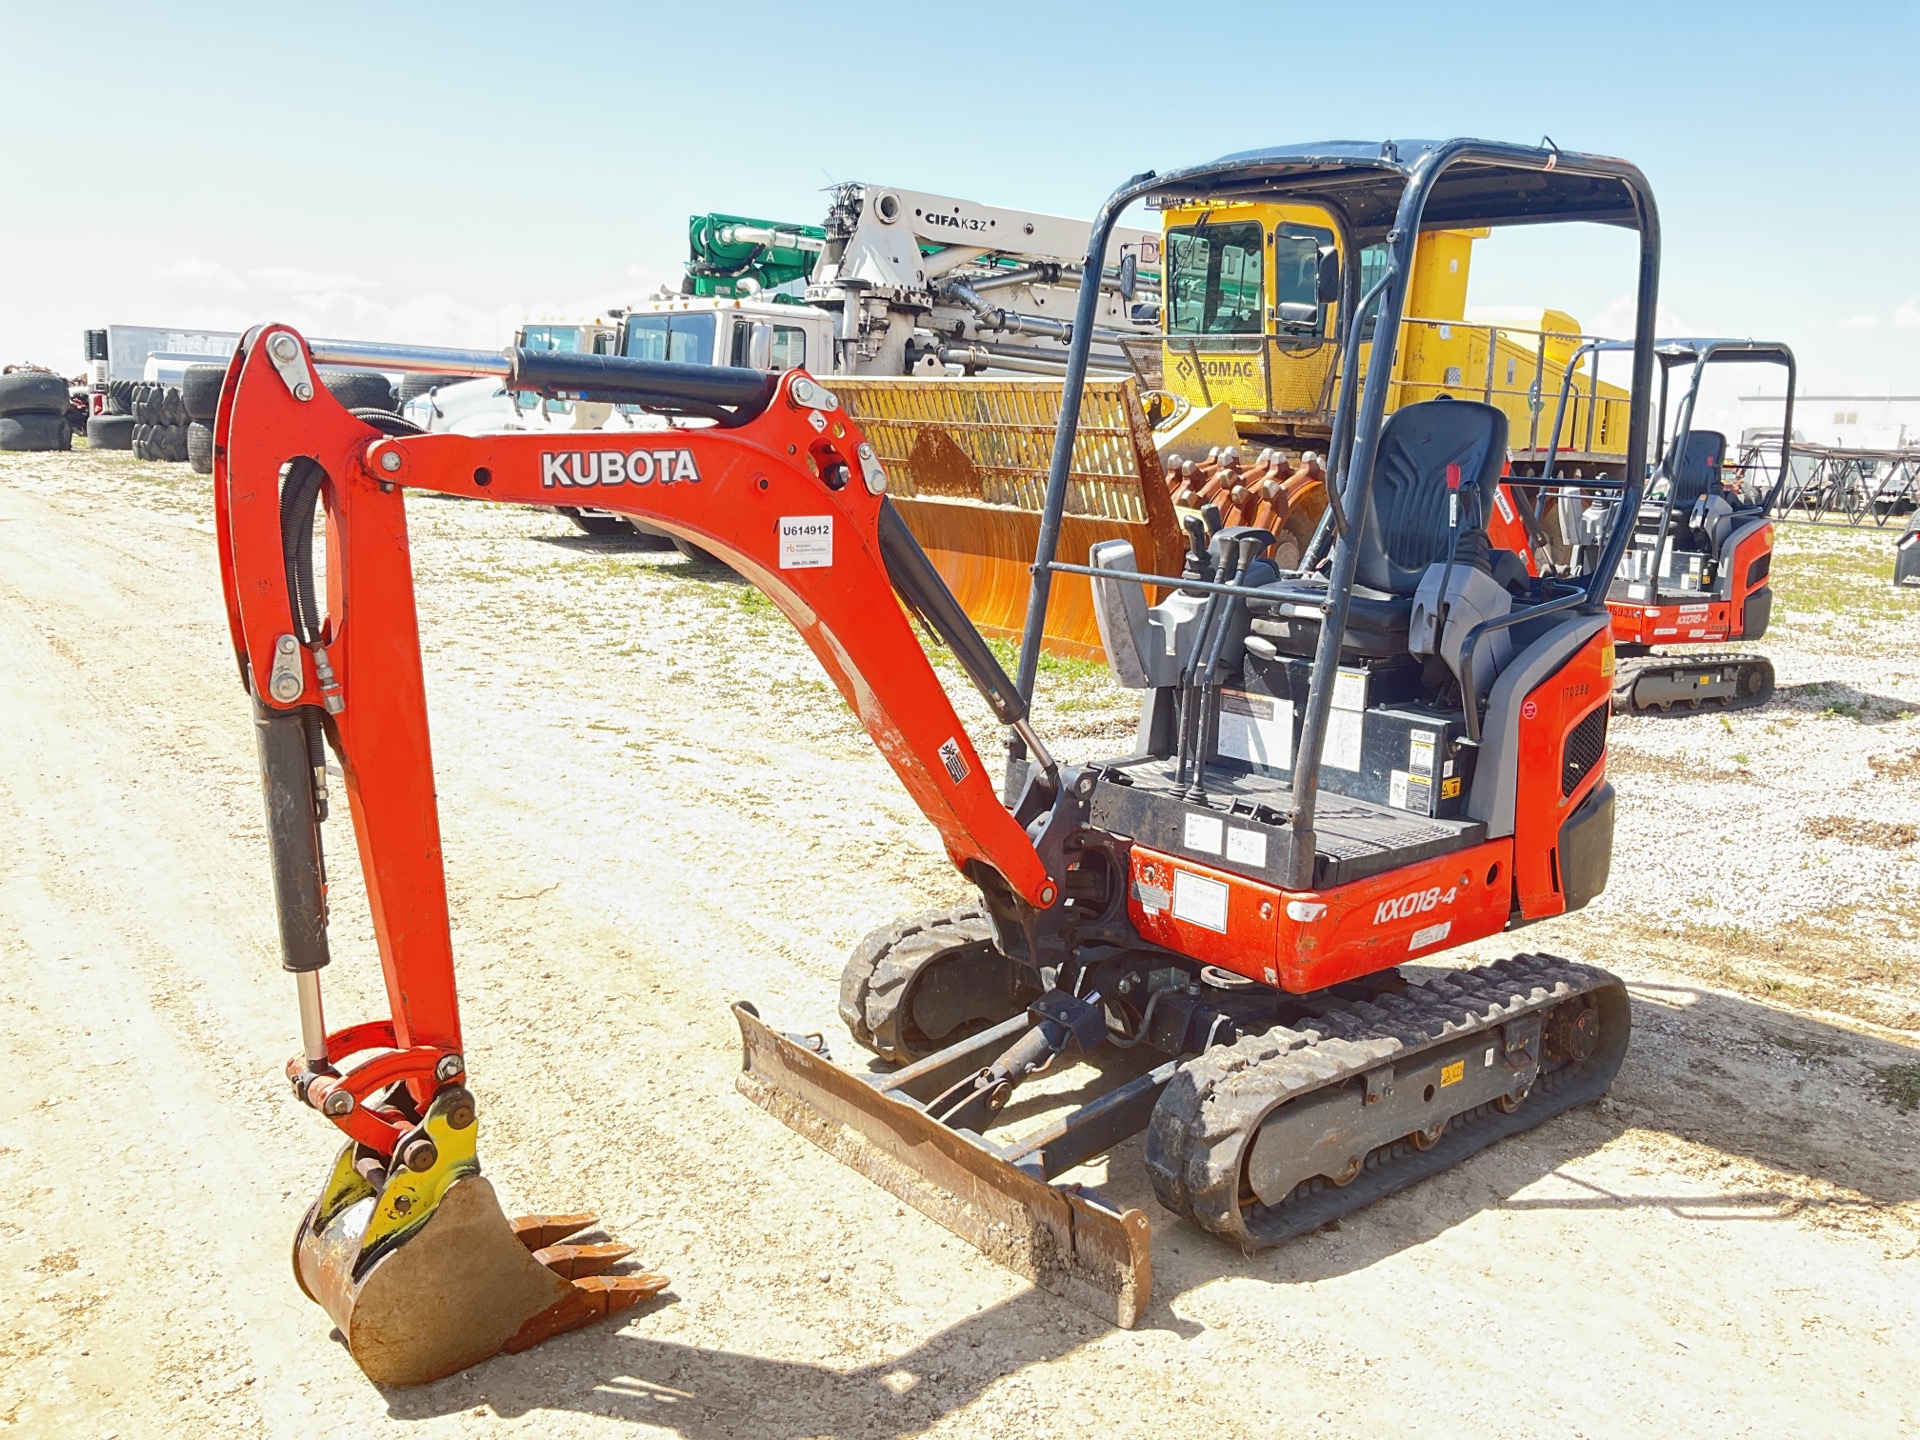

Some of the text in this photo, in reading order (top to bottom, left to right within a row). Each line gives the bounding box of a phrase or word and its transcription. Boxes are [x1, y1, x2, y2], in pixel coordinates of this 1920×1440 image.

[925, 212, 960, 228] CIFA
[766, 251, 775, 262] A
[541, 449, 701, 487] KUBOTA
[783, 525, 829, 536] U614912
[1562, 684, 1589, 699] 170298
[1413, 731, 1432, 741] FUSE
[1372, 886, 1458, 926] KX018-4
